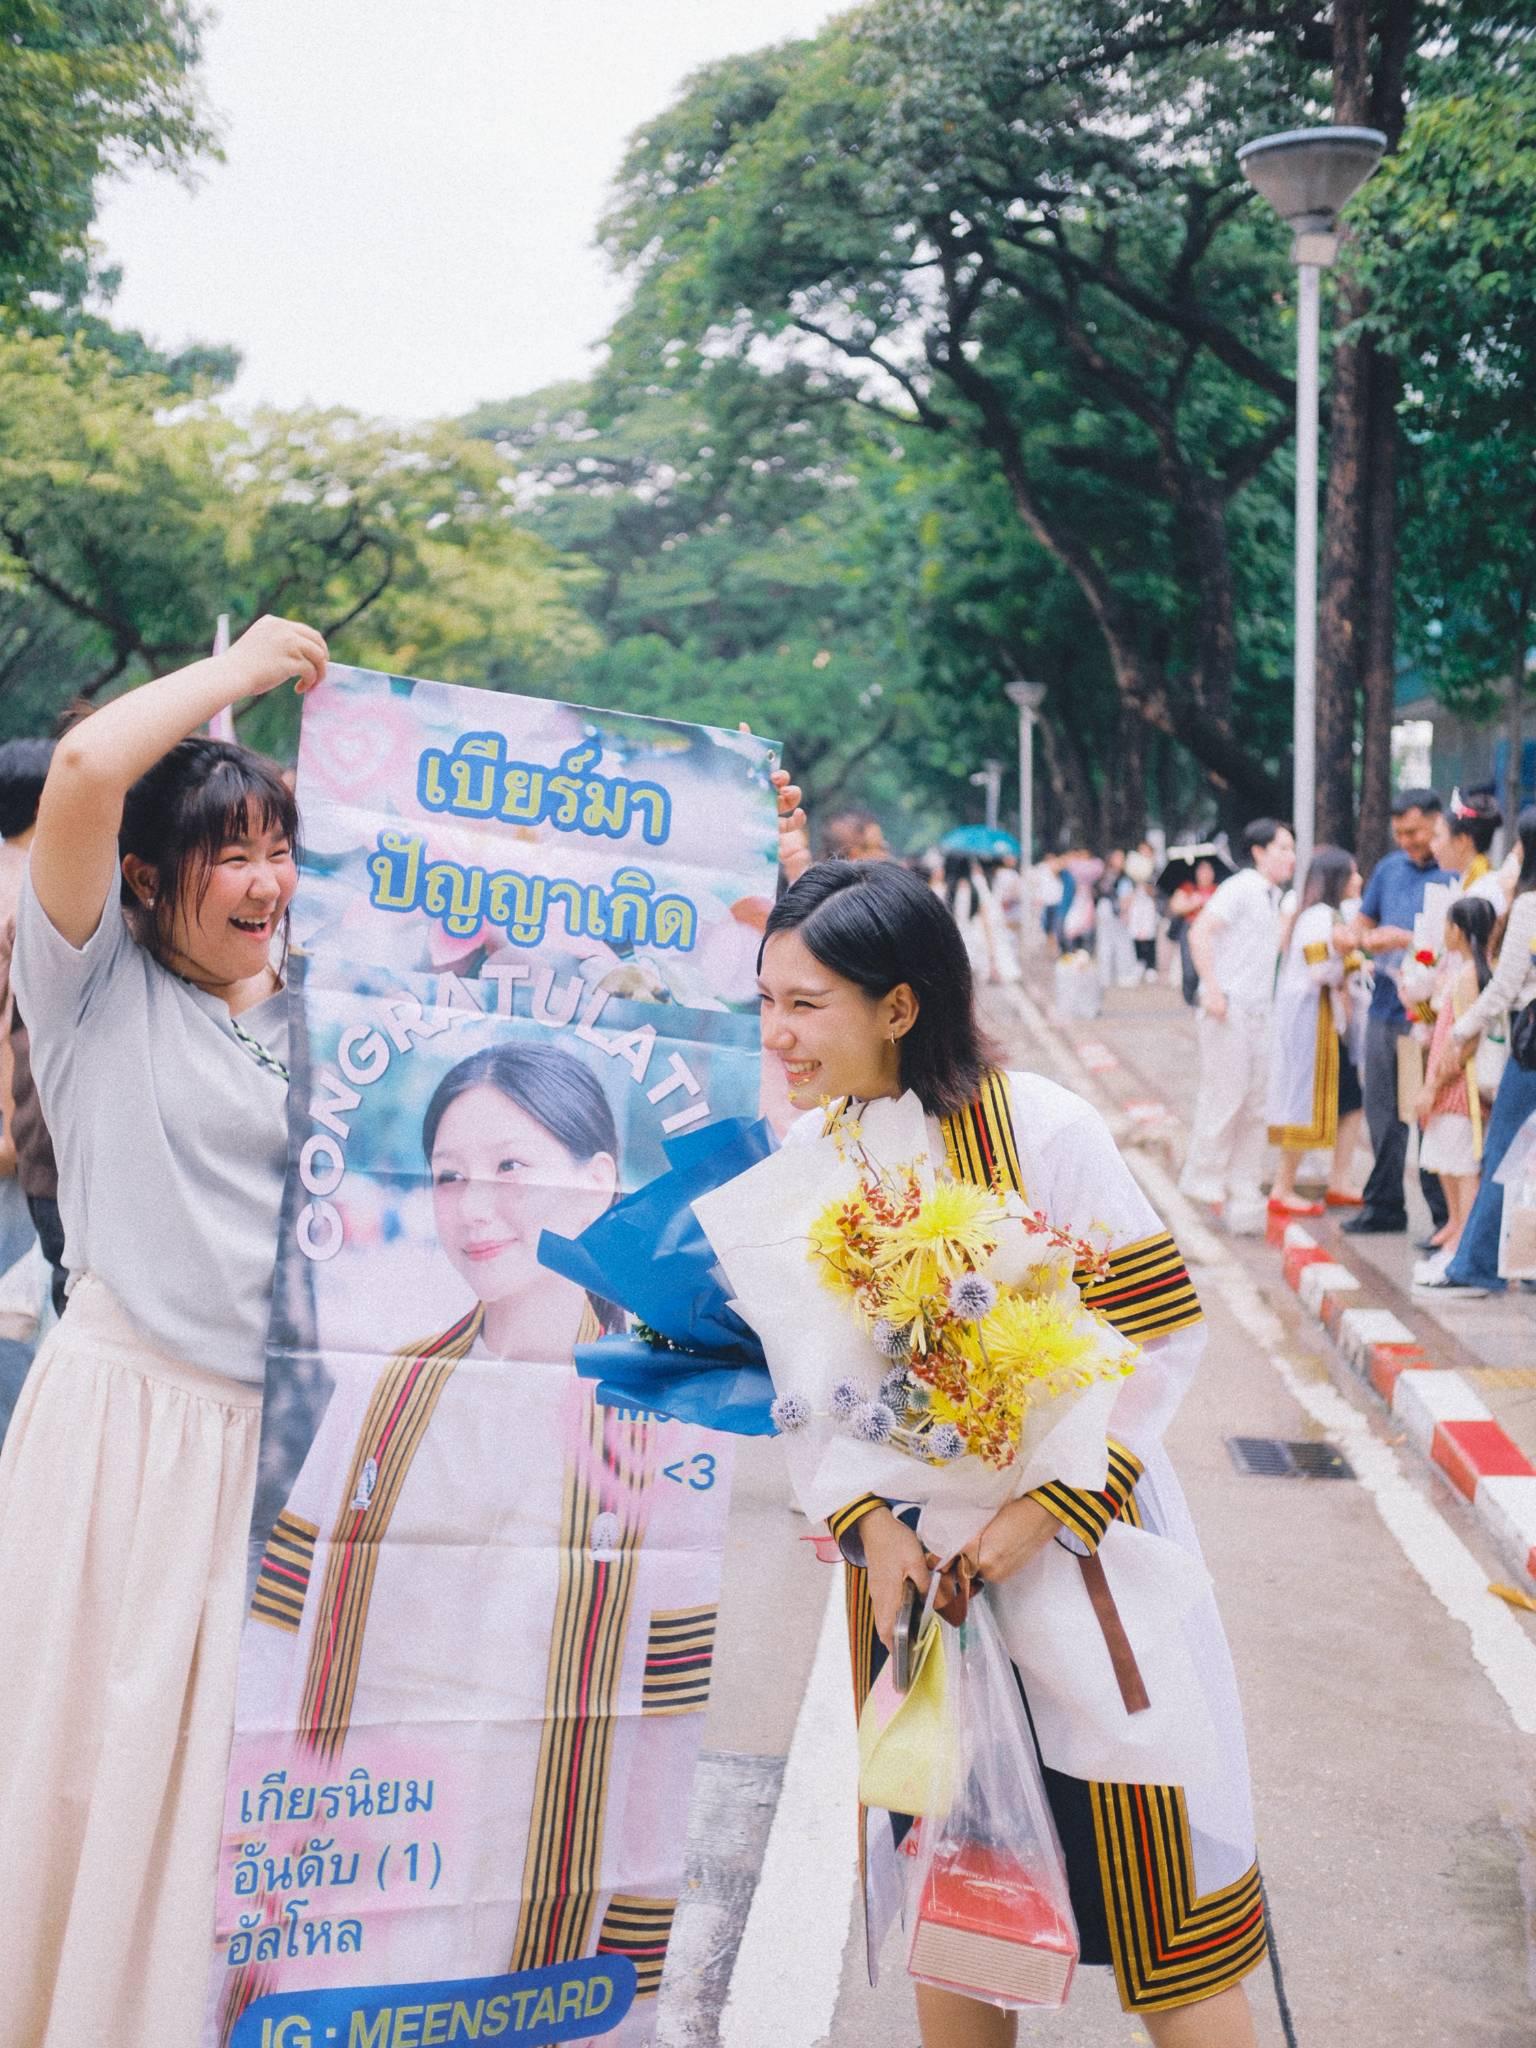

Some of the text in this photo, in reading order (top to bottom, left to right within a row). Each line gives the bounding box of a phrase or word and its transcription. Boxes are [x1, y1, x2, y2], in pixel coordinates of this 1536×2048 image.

[418, 732, 671, 844] เบียร์มา
[367, 831, 697, 951] ปัญญาเกิด
[296, 963, 711, 1261] CONGRATULATI
[662, 1453, 717, 1491] <3
[240, 1767, 435, 1824] เกียรนิยม
[234, 1837, 361, 1895] อันดับ
[226, 1898, 364, 1966] อัลโหล
[347, 1975, 614, 2048] MEENSTARD
